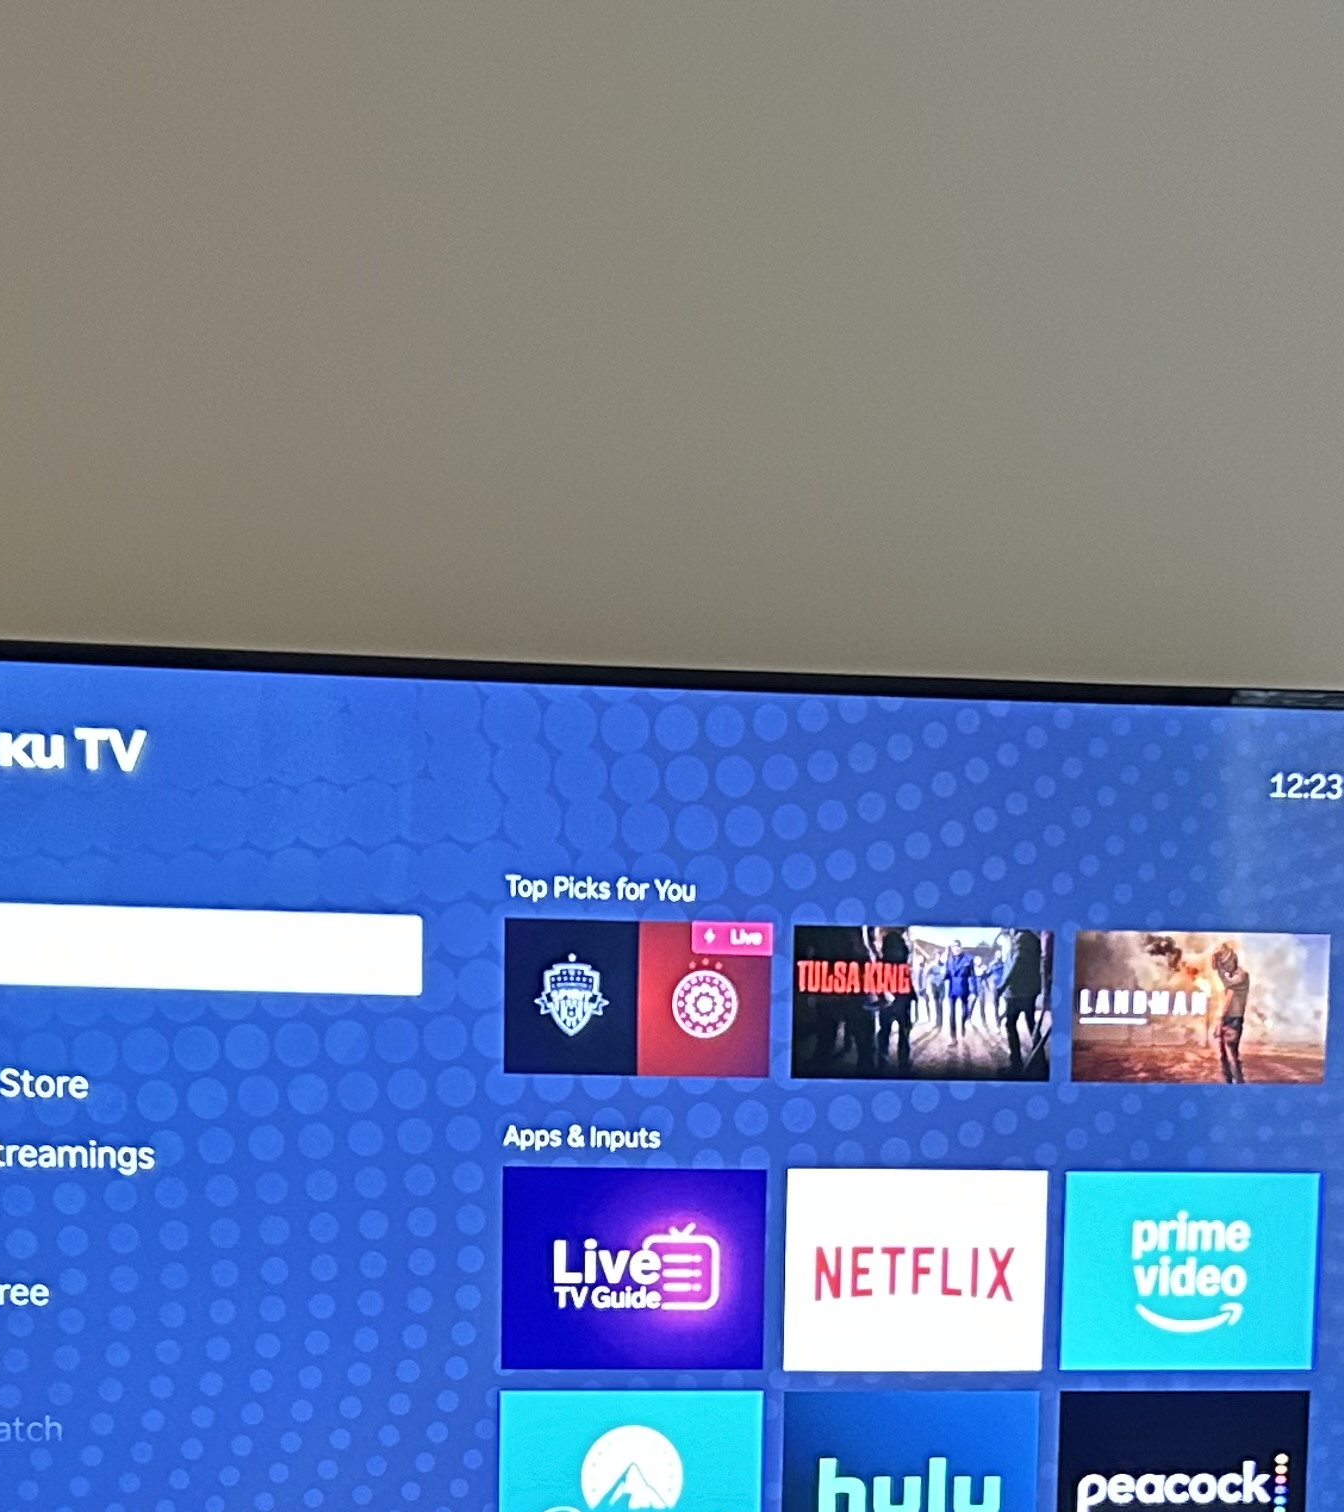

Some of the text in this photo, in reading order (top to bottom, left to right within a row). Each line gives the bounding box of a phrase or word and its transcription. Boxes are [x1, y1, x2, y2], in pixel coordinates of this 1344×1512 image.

[74, 727, 148, 773] TV
[1269, 772, 1343, 801] 12:23
[505, 874, 697, 903] Top Picks for You
[730, 928, 763, 946] Live
[797, 960, 911, 993] TULSA KING
[1079, 988, 1208, 1016] LANDMAN
[0, 1067, 89, 1100] Store
[502, 1124, 661, 1153] Apps & Inputs
[1131, 1209, 1252, 1261] prime
[553, 1237, 662, 1285] Live
[814, 1246, 1015, 1302] NETFLIX
[1132, 1255, 1248, 1297] video
[553, 1285, 662, 1309] TV Guide
